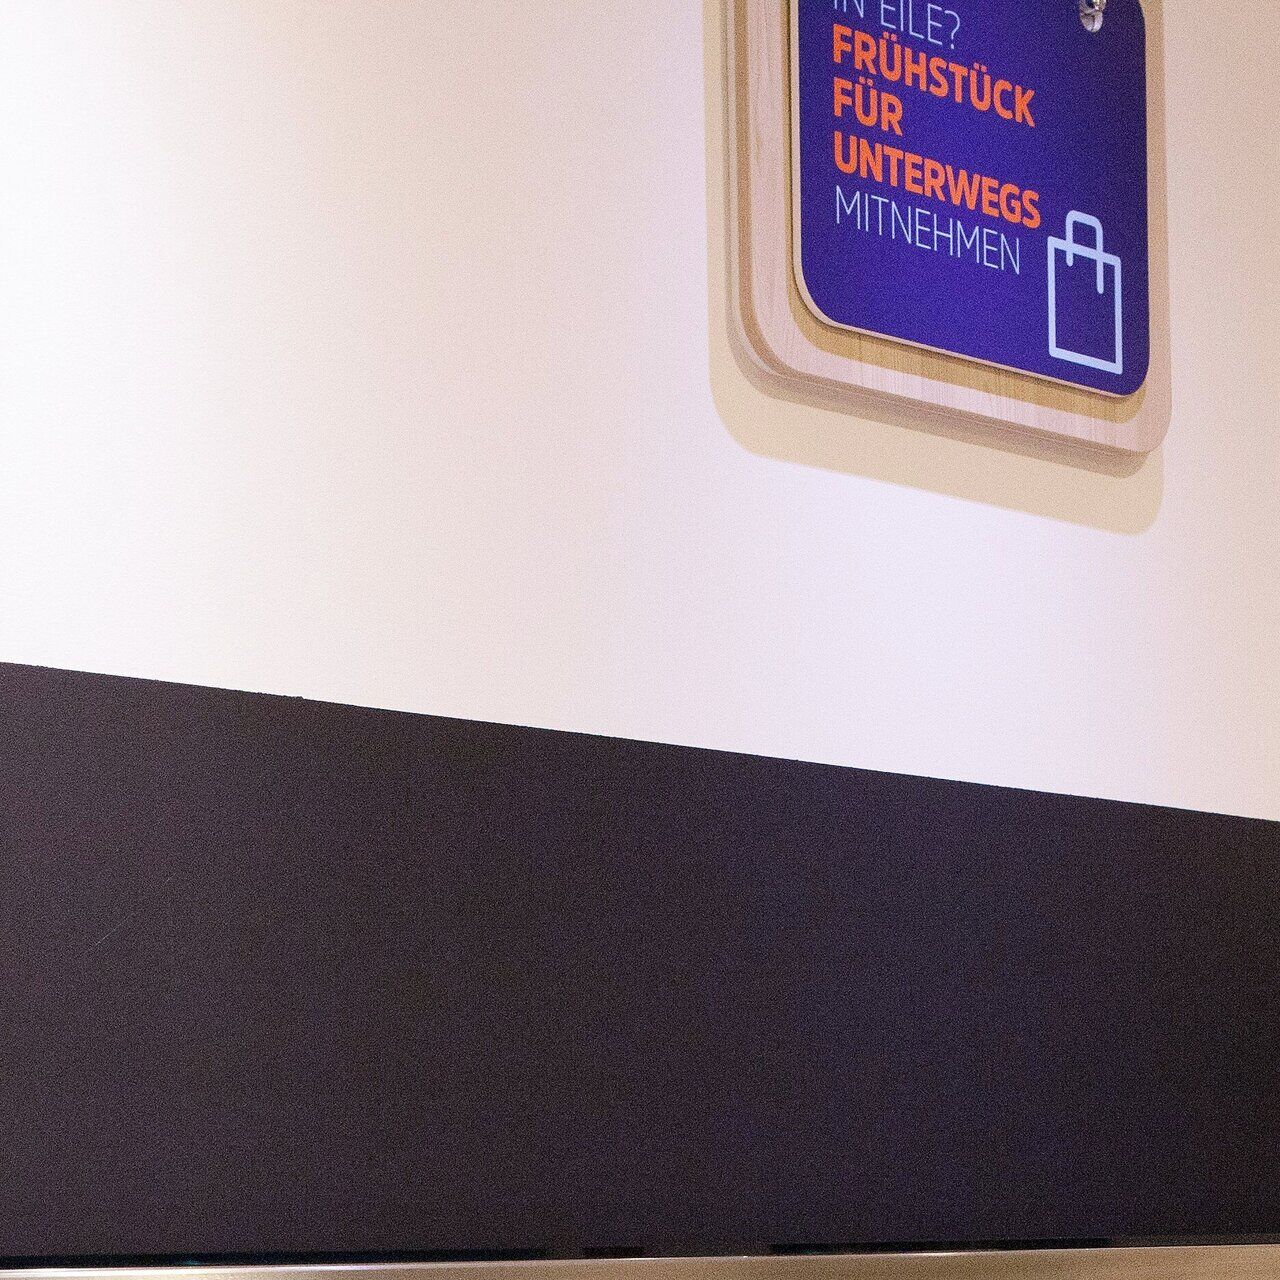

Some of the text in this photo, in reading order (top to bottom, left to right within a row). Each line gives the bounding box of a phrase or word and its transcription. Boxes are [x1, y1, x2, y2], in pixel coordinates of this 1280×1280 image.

[880, 0, 961, 49] EILE?
[832, 24, 1036, 127] FRÜHSTÜCK
[833, 77, 903, 136] FÜR
[834, 131, 1041, 228] UNTERWEGS
[836, 185, 1020, 275] MITNEHMEN
